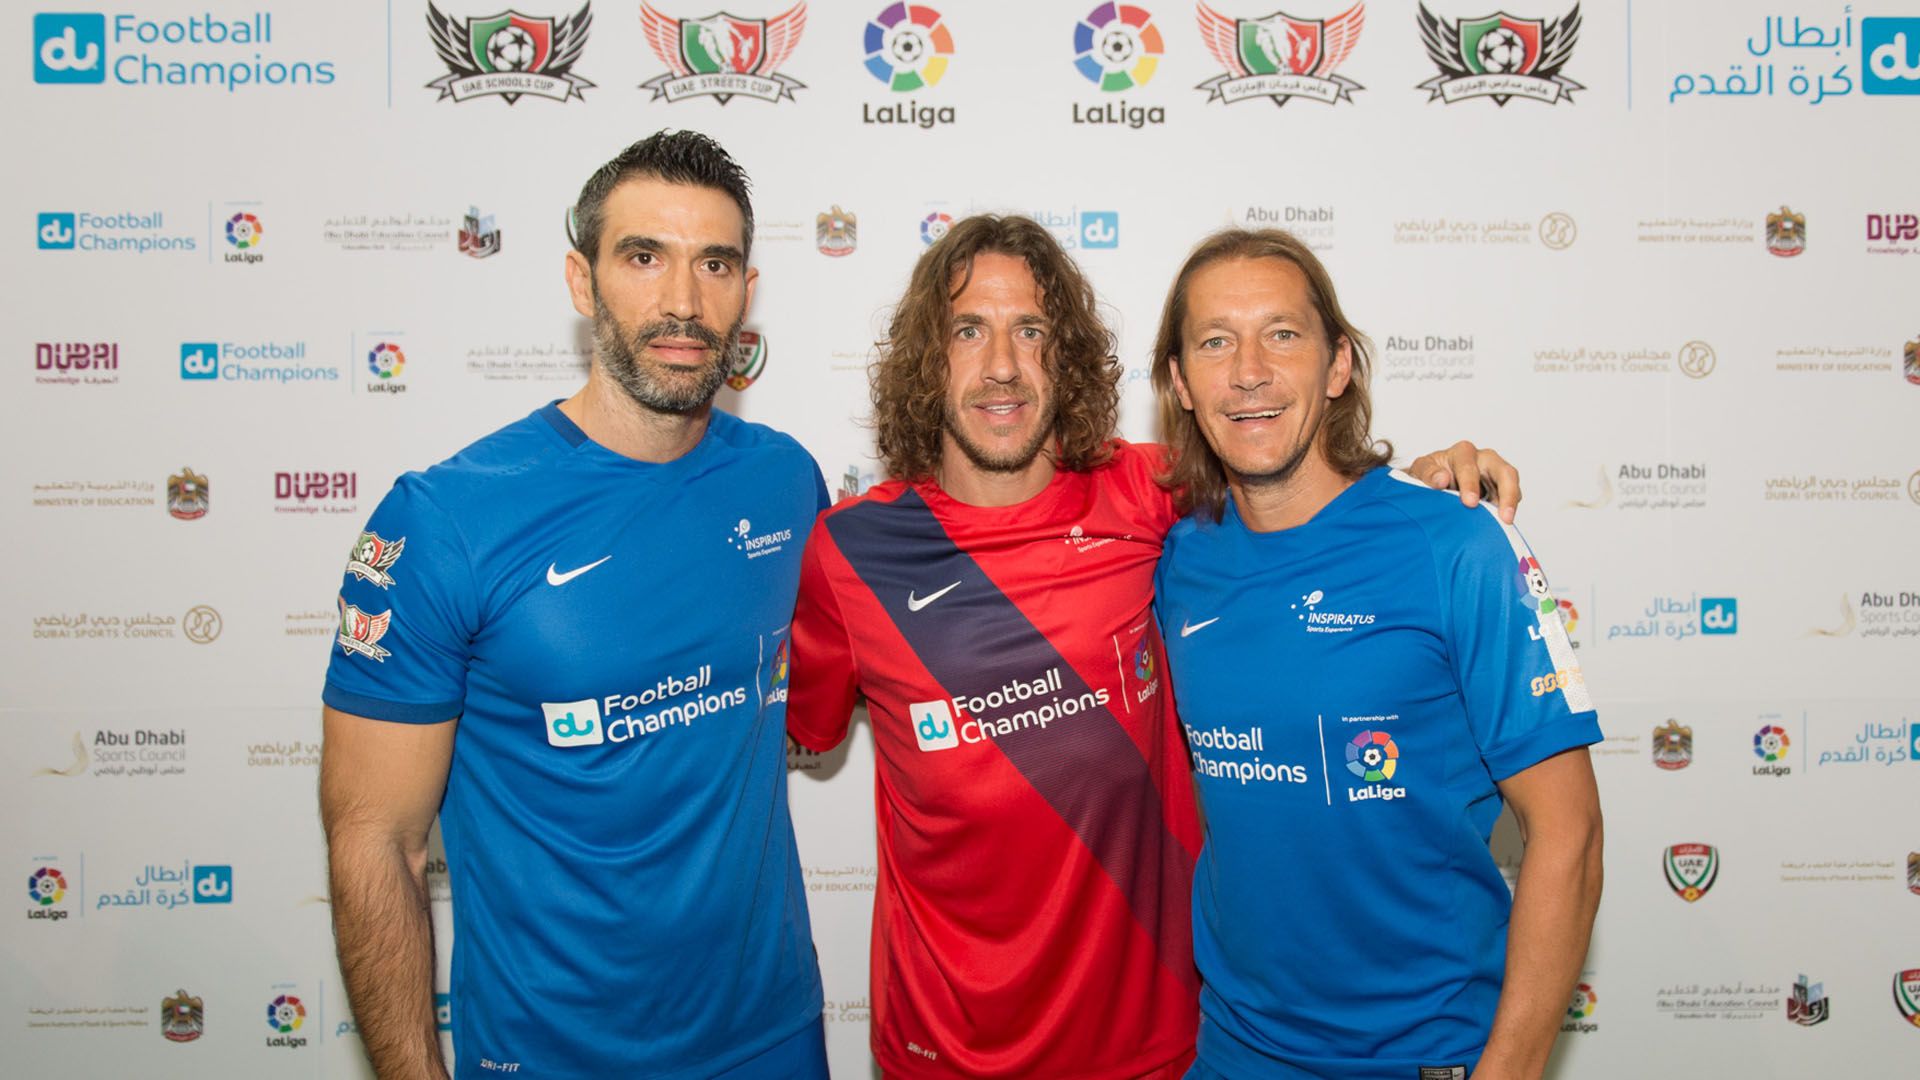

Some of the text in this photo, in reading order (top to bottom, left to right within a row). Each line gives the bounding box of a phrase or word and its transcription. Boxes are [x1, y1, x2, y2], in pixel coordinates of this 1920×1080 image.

[115, 13, 271, 43] Football
[1748, 4, 1852, 57] أبطال
[41, 27, 99, 71] du
[114, 54, 335, 92] Champions
[462, 77, 555, 93] UAE SCHOOLS CUP
[672, 78, 773, 95] UAE STREETS CUP
[1669, 64, 1852, 105] كرة القدم
[863, 101, 956, 129] LaLiga
[1073, 101, 1166, 129] LaLiga
[79, 212, 163, 229] Football
[1246, 206, 1334, 221] Abu Dhabi
[40, 219, 72, 244] du
[1684, 235, 1697, 243] OF
[1699, 235, 1754, 243] EDUCATION
[79, 234, 196, 253] Champions
[224, 252, 264, 264] LaLiga
[222, 342, 306, 359] Football
[1385, 336, 1473, 351] Abu Dhabi
[36, 342, 118, 370] DUBAI
[183, 349, 216, 374] du
[1385, 353, 1474, 367] Sports Council
[1533, 346, 1586, 362] الرياضي
[1622, 346, 1671, 361] مجلس
[222, 364, 339, 384] Champions
[1776, 363, 1892, 371] MINISTRY OF EDUCATION
[367, 382, 406, 394] LaLiga
[1619, 464, 1706, 479] Abu Dhabi
[275, 472, 357, 500] DUBAI
[1619, 482, 1706, 496] Sports Council
[1765, 475, 1816, 490] الرياضي
[1851, 475, 1900, 489] مجلس
[33, 499, 154, 507] MINISTRY OF EDUCATION
[745, 529, 792, 551] INSPIRATUS
[1645, 592, 1696, 618] أبطال
[1861, 592, 1894, 607] Abu
[33, 613, 87, 628] الرياضي
[124, 613, 176, 627] مجلس
[1308, 612, 1375, 625] INSPIRATUS
[1704, 604, 1734, 629] du
[1860, 610, 1901, 624] Sports
[75, 630, 119, 639] SPORTS
[124, 630, 175, 639] COUNCIL
[286, 628, 330, 636] MINISTRY
[1306, 626, 1324, 634] Sports
[1608, 621, 1696, 640] كرة القدم
[604, 664, 711, 716] Football
[952, 668, 1063, 718] Football
[607, 687, 746, 743] Champions
[961, 687, 1110, 744] Champions
[1349, 715, 1385, 723] partnership
[553, 712, 594, 738] du
[918, 712, 949, 741] du
[1855, 718, 1907, 743] أبطال
[94, 729, 186, 745] Abu Dhabi
[1186, 724, 1264, 751] Football
[94, 749, 186, 763] Sports Council
[247, 741, 301, 756] الرياضي
[1819, 746, 1907, 766] كرة القدم
[248, 757, 284, 766] DUBAI
[1192, 752, 1308, 785] Champions
[1752, 765, 1791, 777] LaLiga
[1349, 785, 1406, 802] LaLiga
[1679, 859, 1704, 867] UAE
[136, 860, 189, 886] أبطال
[197, 873, 228, 897] du
[826, 883, 876, 892] EDUCATIO
[97, 889, 190, 910] كرة القدم
[28, 908, 67, 921] LaLiga
[267, 1036, 307, 1049] LaLiga
[480, 1058, 520, 1073] DRI-FIT
